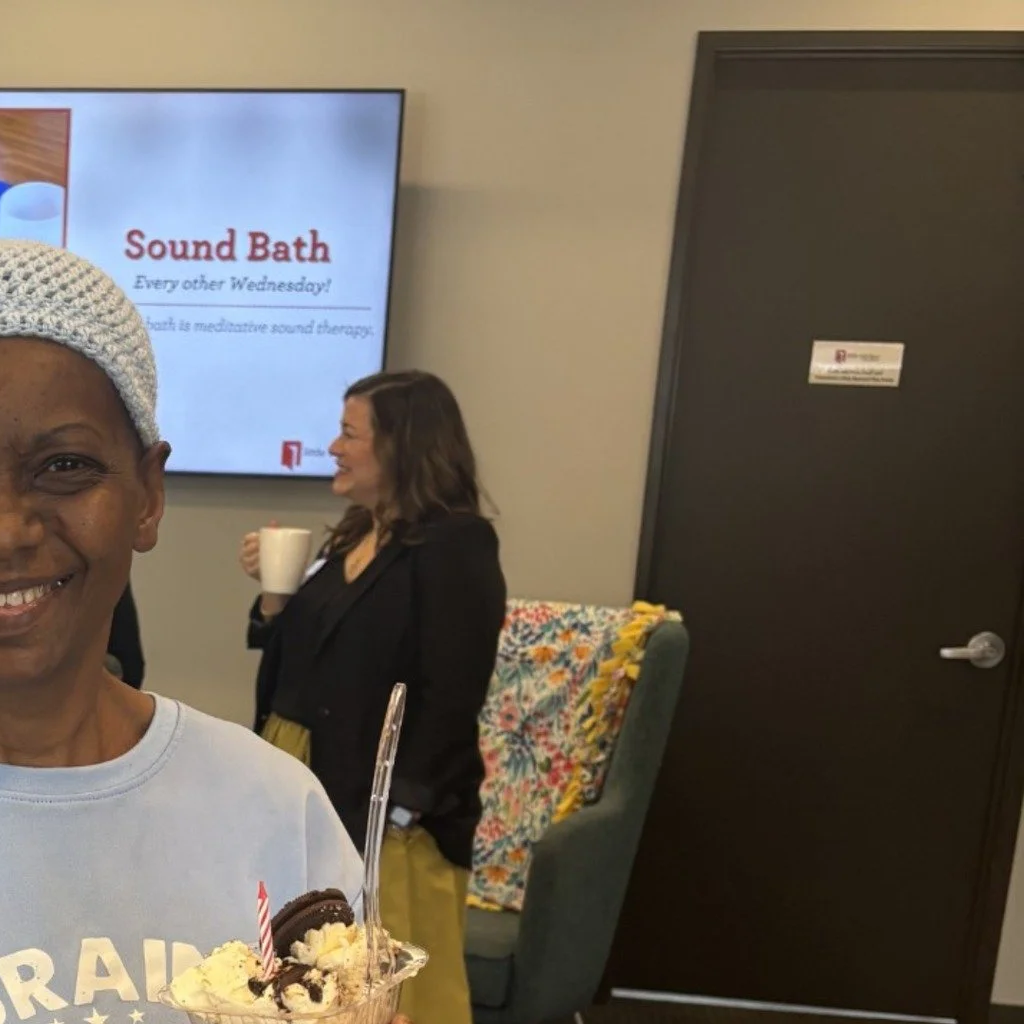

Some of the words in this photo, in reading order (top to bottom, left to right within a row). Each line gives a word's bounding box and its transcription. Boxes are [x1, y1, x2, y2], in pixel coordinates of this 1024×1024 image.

[125, 228, 237, 262] Sound
[246, 229, 331, 263] Bath
[133, 275, 178, 294] Every
[181, 275, 225, 292] other
[230, 276, 332, 297] Wednesday!
[145, 316, 176, 333] bath
[179, 318, 191, 332] is
[193, 317, 268, 336] meditative
[270, 319, 314, 336] sound
[316, 320, 374, 340] therapy.
